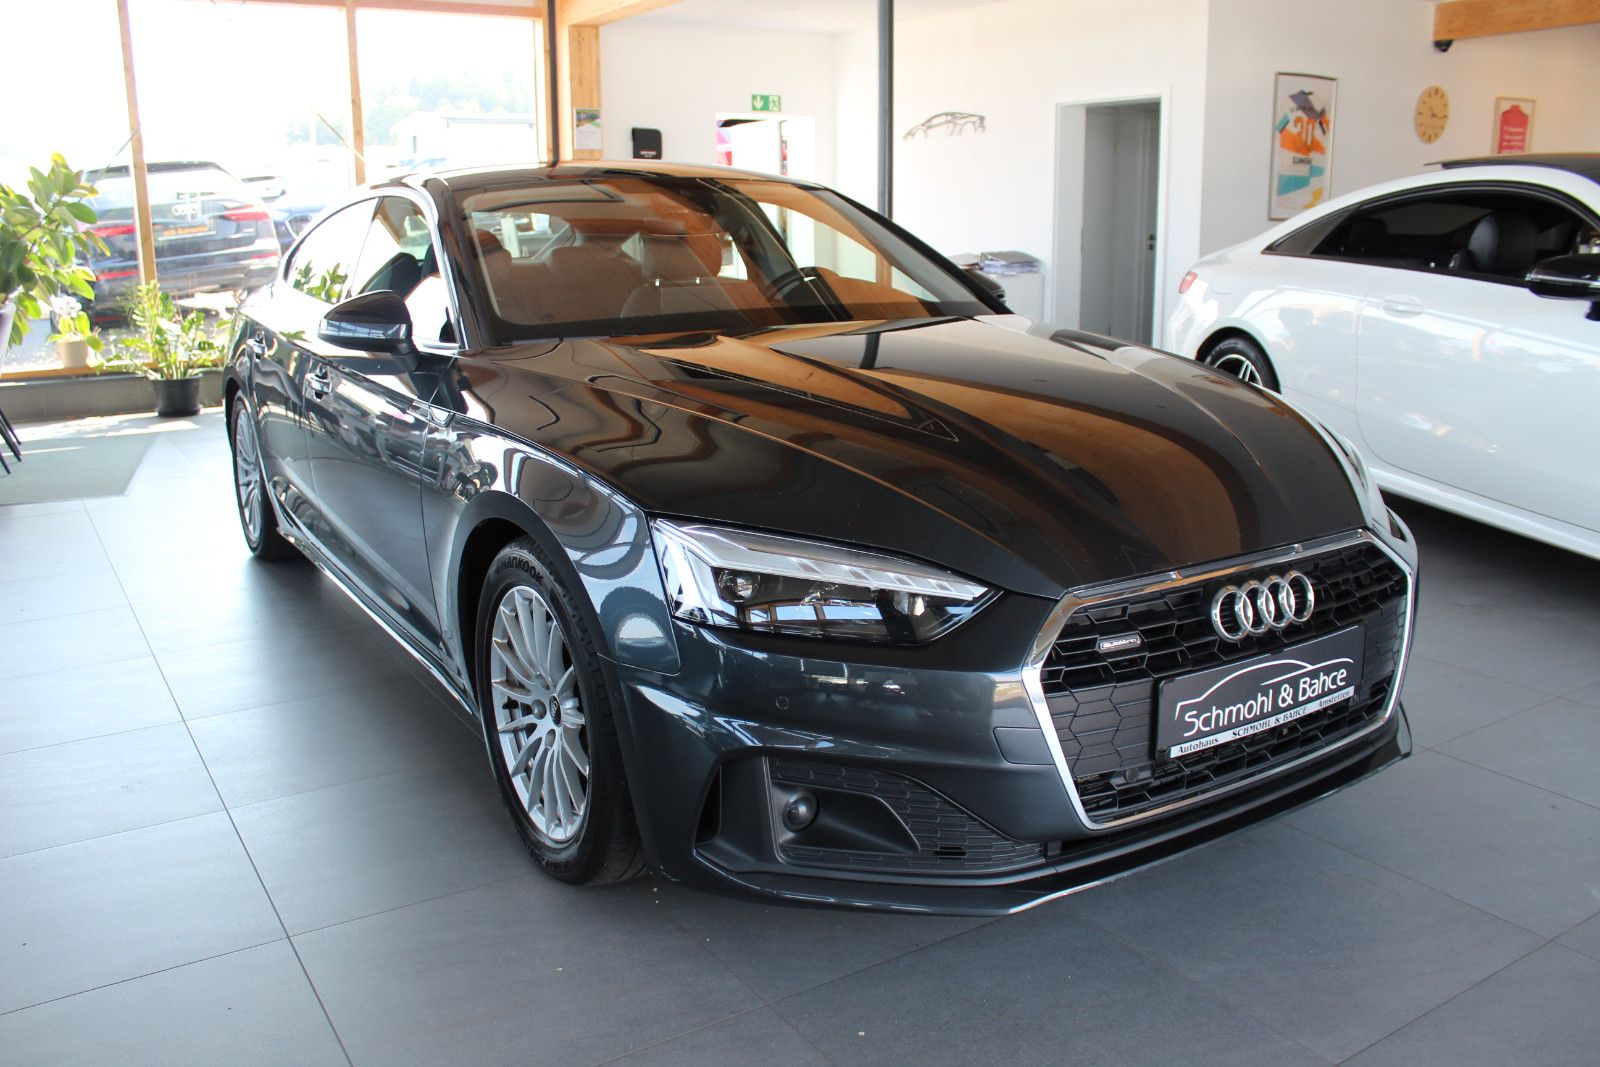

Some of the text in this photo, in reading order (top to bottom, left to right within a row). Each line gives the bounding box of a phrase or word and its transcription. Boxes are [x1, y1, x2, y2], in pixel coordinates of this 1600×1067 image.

[1177, 737, 1219, 756] Autohaus
[1231, 715, 1272, 739] SCHMOHL
[1282, 705, 1308, 722] BAHCE
[1183, 668, 1347, 737] Schmohl & Bahce
